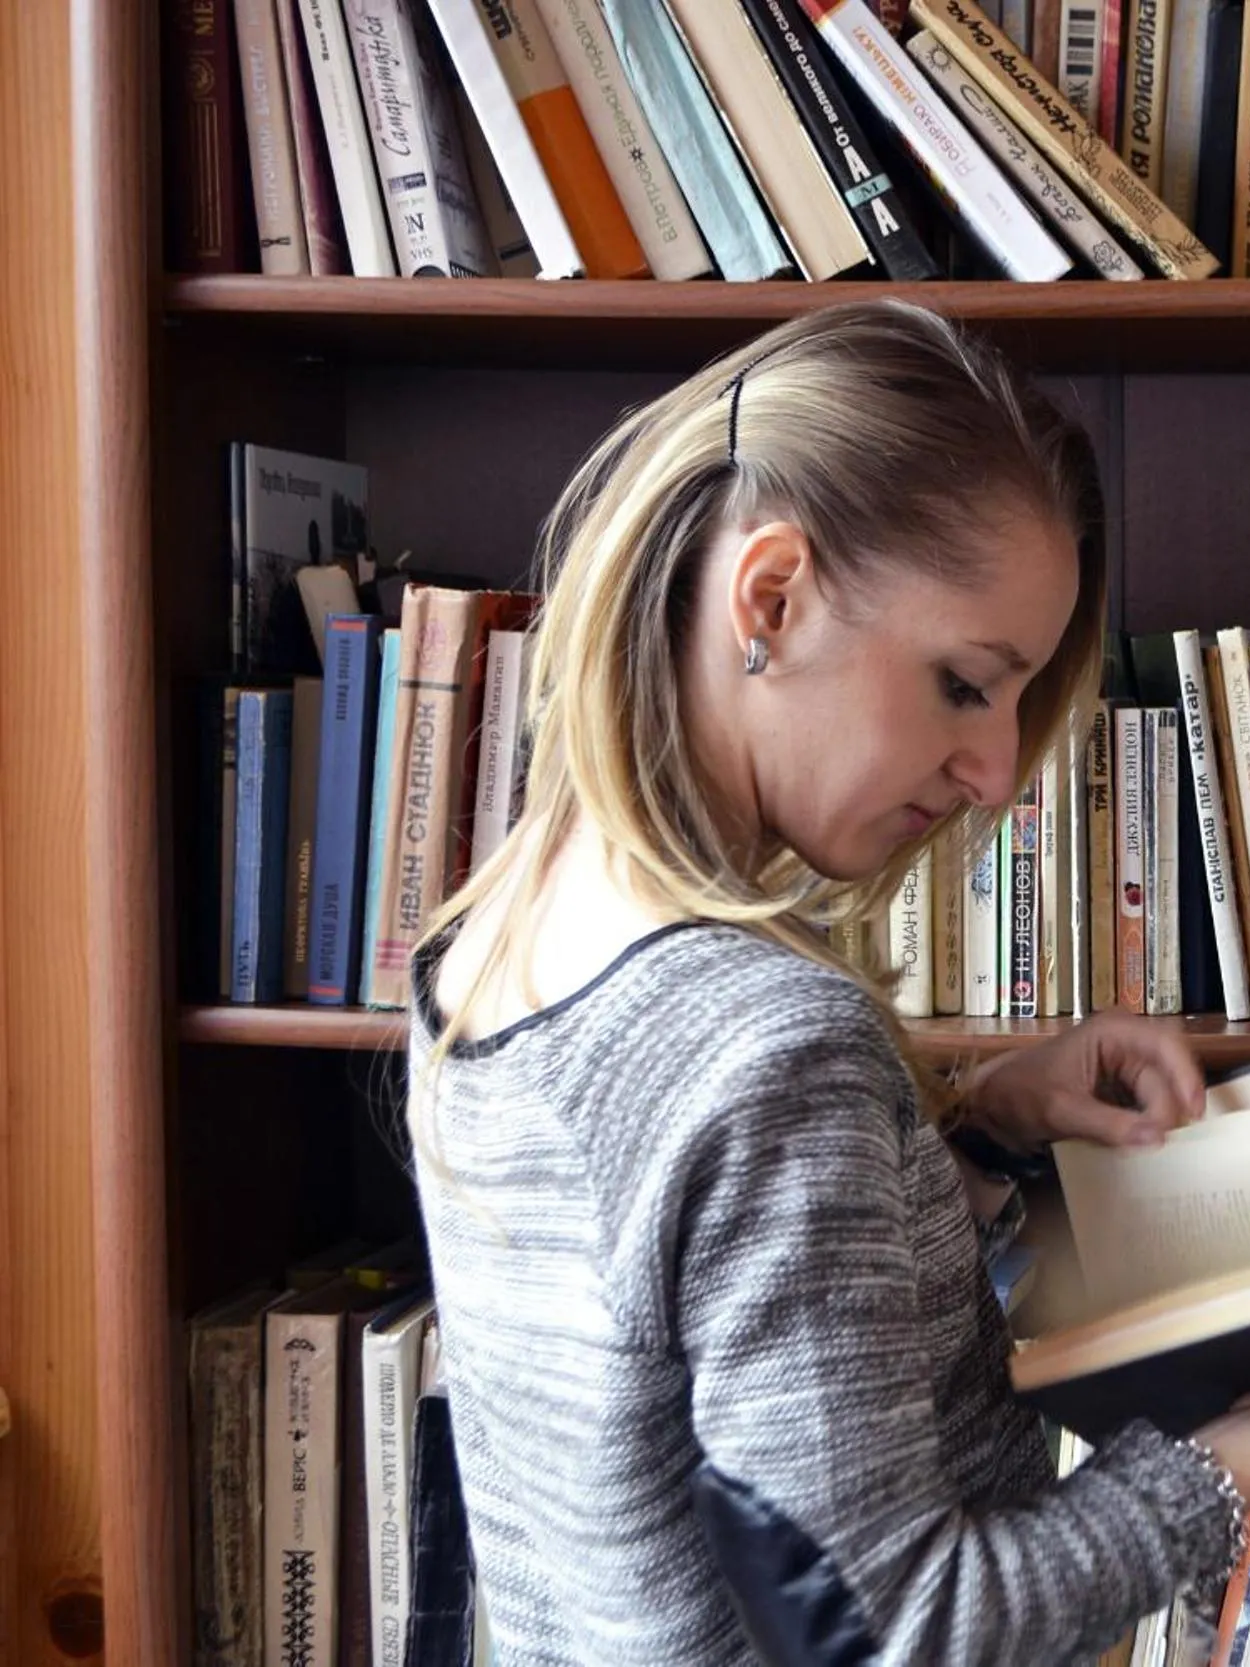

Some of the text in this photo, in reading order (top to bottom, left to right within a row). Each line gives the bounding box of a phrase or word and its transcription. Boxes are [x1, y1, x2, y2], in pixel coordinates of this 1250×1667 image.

[785, 31, 801, 52] до
[832, 127, 848, 147] От
[396, 700, 438, 931] ИВАН СТАДНЮК
[1013, 859, 1032, 947] ЛЕОНОВ
